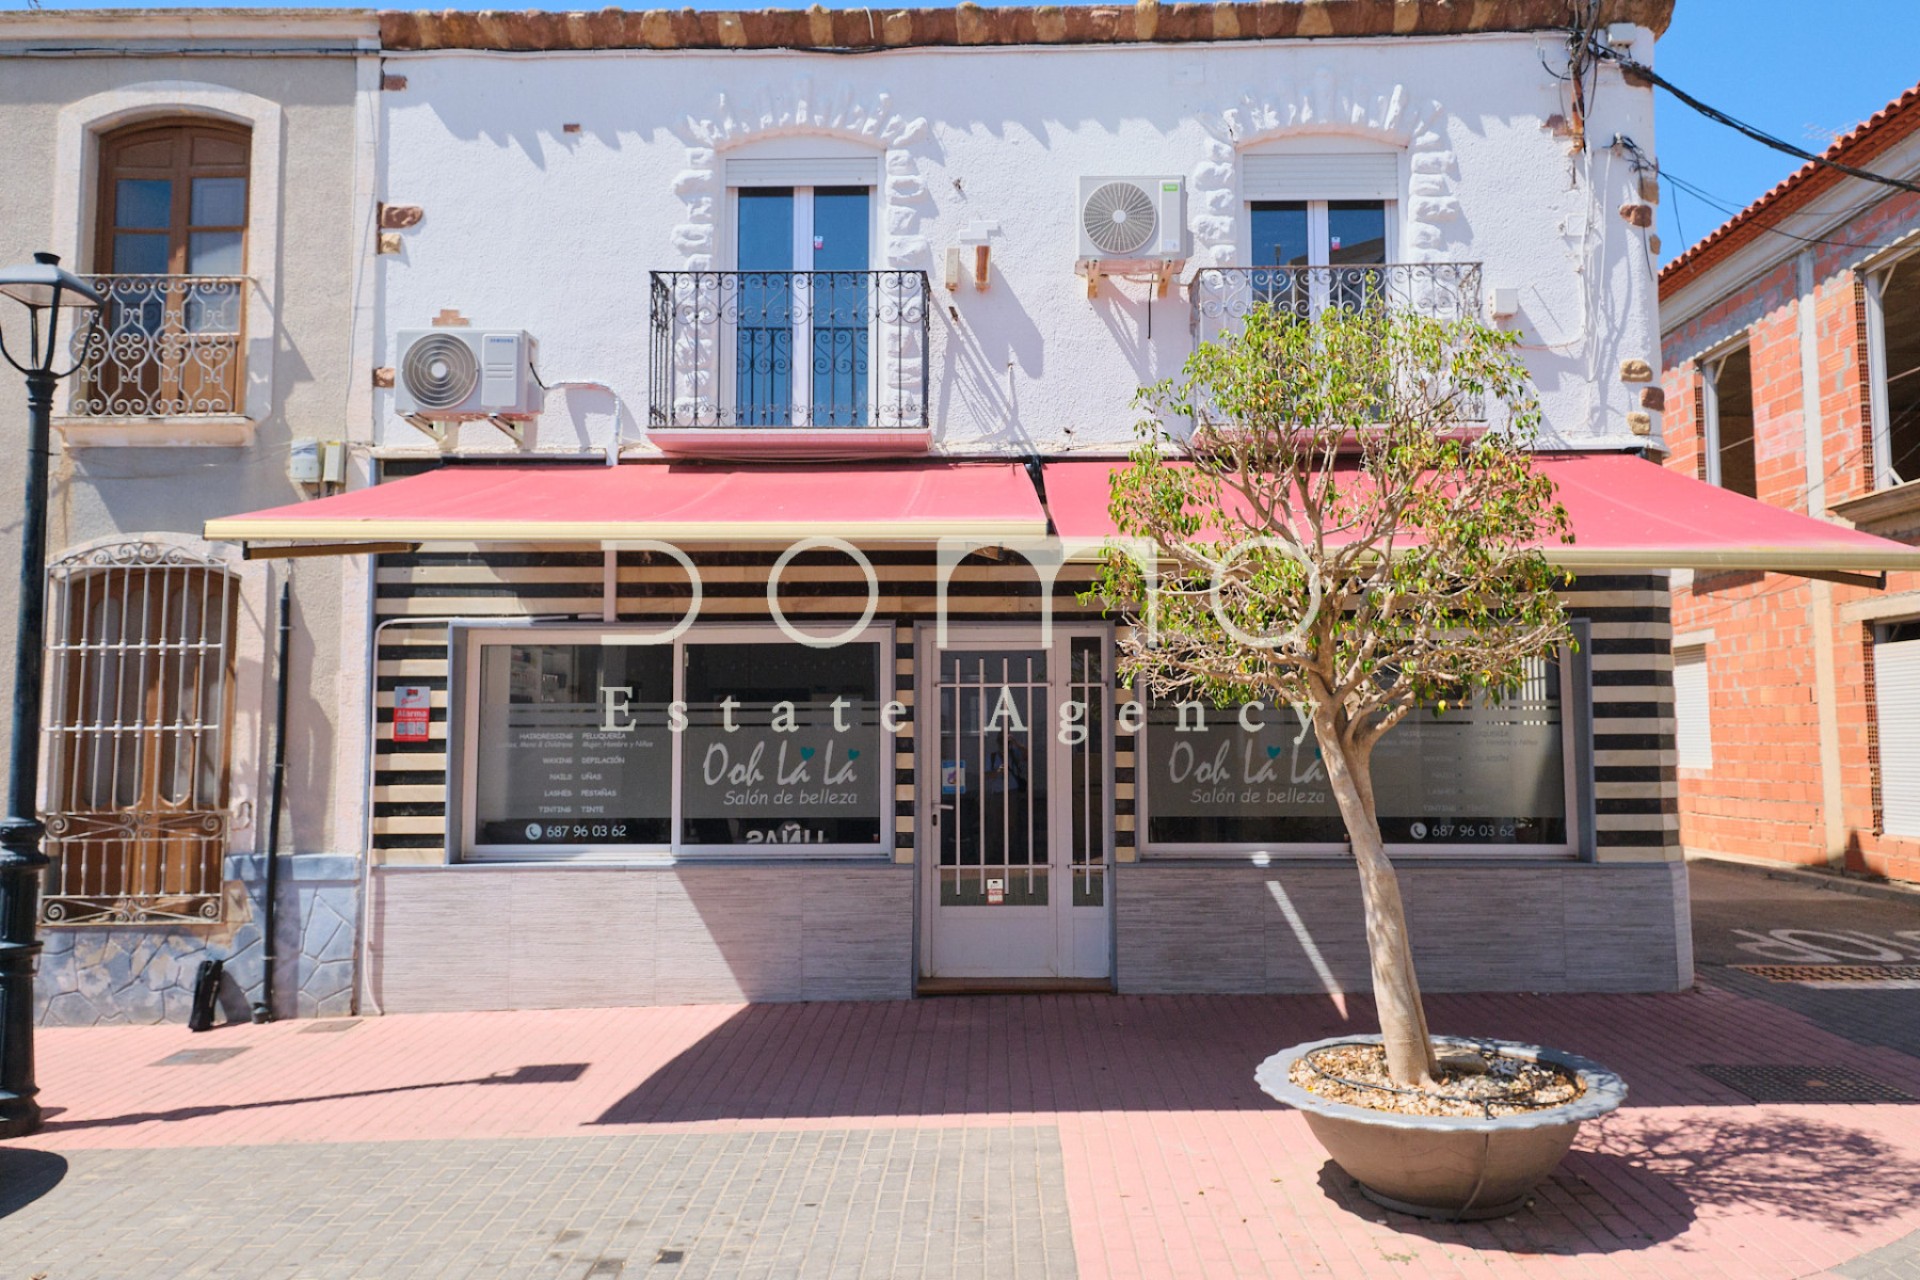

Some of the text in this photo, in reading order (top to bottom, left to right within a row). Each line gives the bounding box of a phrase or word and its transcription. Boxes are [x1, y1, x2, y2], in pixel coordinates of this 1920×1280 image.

[581, 755, 625, 764] DEPILACIÓN
[703, 740, 765, 786] Ooh
[1168, 739, 1231, 785] Ooh
[581, 771, 602, 780] UÑAS
[723, 788, 858, 805] Salón de belleza
[1190, 787, 1325, 804] Salón de belleza
[546, 825, 627, 838] 687 96 03 62
[1432, 825, 1515, 837] 687 96 03 62
